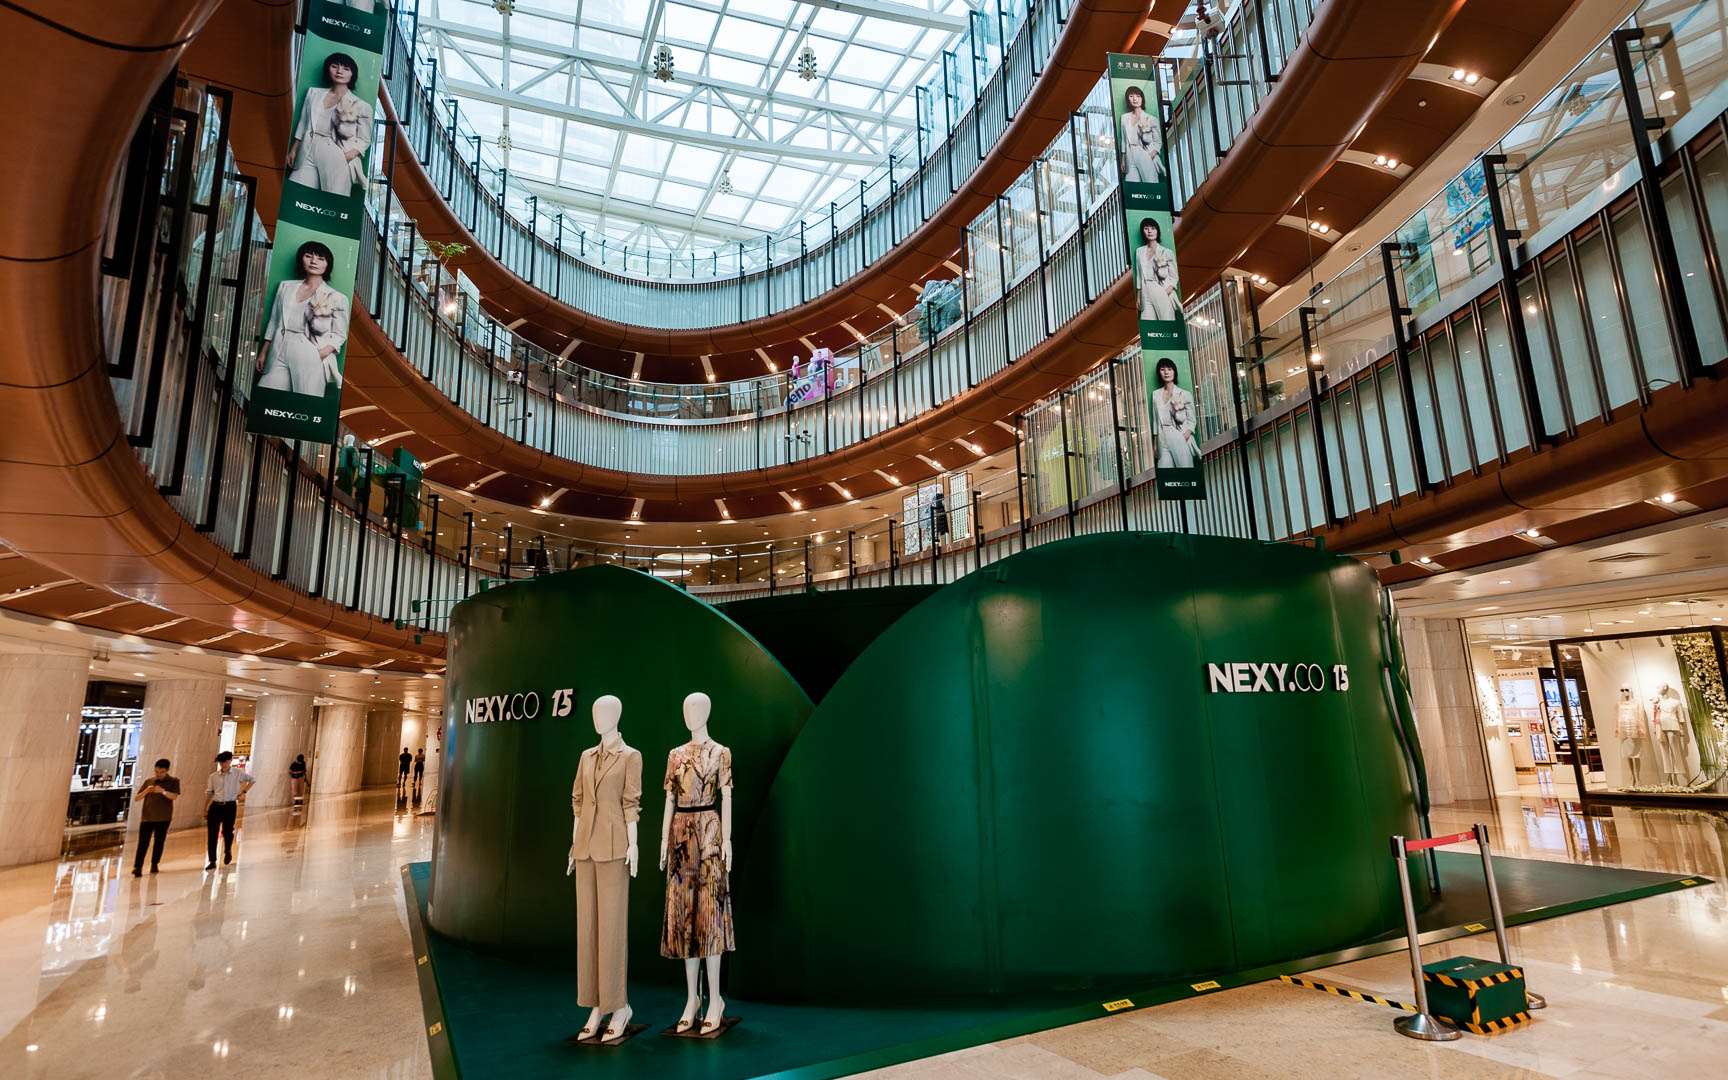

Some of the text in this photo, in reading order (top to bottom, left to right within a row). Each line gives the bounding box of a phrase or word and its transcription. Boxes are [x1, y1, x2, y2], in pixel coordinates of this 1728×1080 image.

[322, 16, 360, 32] NEXY.CO
[295, 201, 337, 217] NEXY.CO
[264, 408, 309, 421] NEXY.CO
[1208, 662, 1350, 693] NEXY.CO 15
[465, 688, 574, 724] NEXY.CO 15
